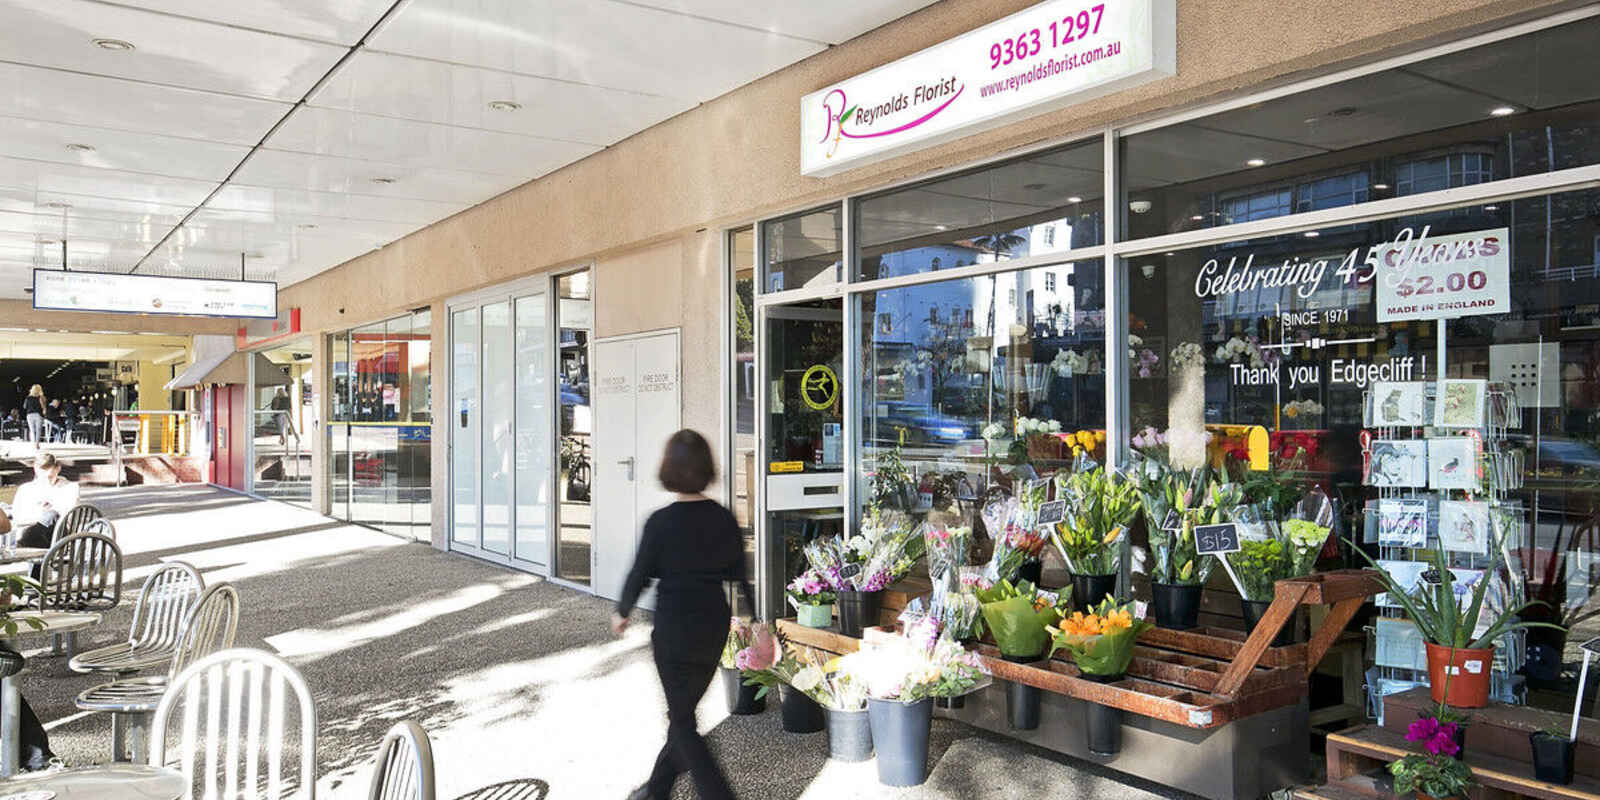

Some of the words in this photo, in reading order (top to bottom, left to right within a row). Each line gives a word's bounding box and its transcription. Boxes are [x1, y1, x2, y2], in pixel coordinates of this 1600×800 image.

[989, 28, 1042, 70] 9363
[1048, 4, 1105, 49] 1297
[980, 40, 1121, 99] www.reynoldsflorist.com.au
[855, 91, 909, 126] Reynolds
[913, 75, 957, 107] Florist
[1195, 254, 1328, 299] Celebrating
[1336, 246, 1382, 285] 45
[1396, 270, 1488, 299] $2.00
[1324, 309, 1349, 324] 1971
[1387, 304, 1419, 315] MADE
[1421, 304, 1434, 312] IN
[1438, 299, 1495, 311] ENGLAND
[1230, 364, 1280, 386] Thank
[1289, 367, 1319, 389] you
[1331, 358, 1414, 389] Edgecliff
[1202, 529, 1232, 549] $15
